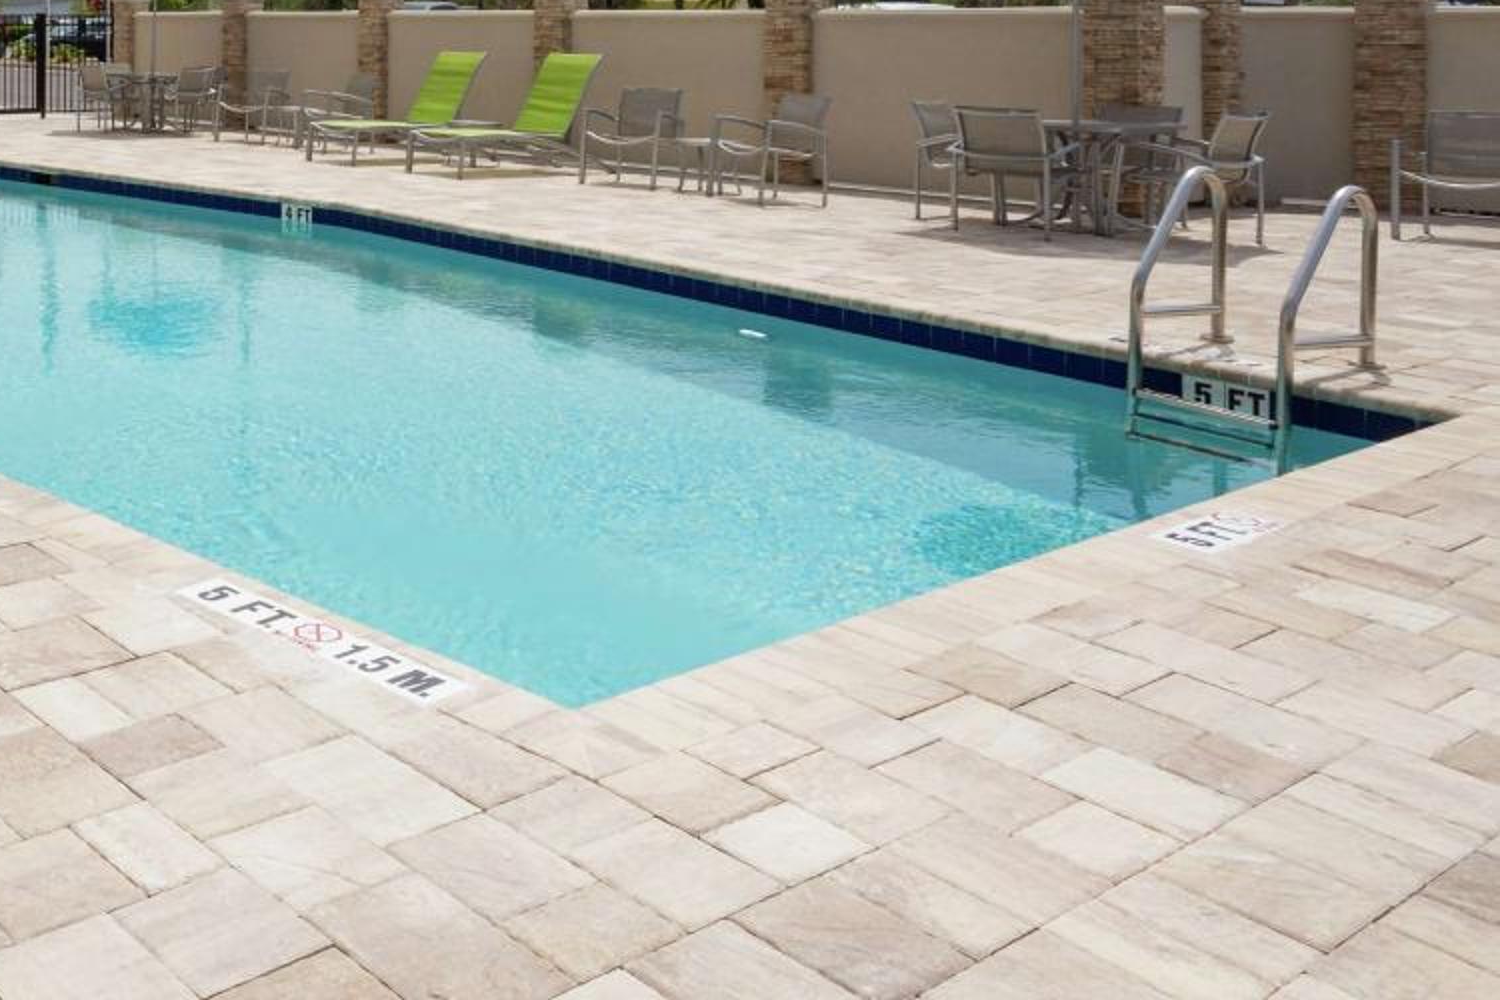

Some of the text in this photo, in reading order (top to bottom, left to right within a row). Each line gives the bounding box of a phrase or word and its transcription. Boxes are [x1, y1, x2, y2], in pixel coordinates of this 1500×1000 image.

[1195, 382, 1264, 416] 5 FT
[197, 585, 240, 601] 5
[334, 643, 402, 673] 1.5
[388, 669, 446, 697] M.
